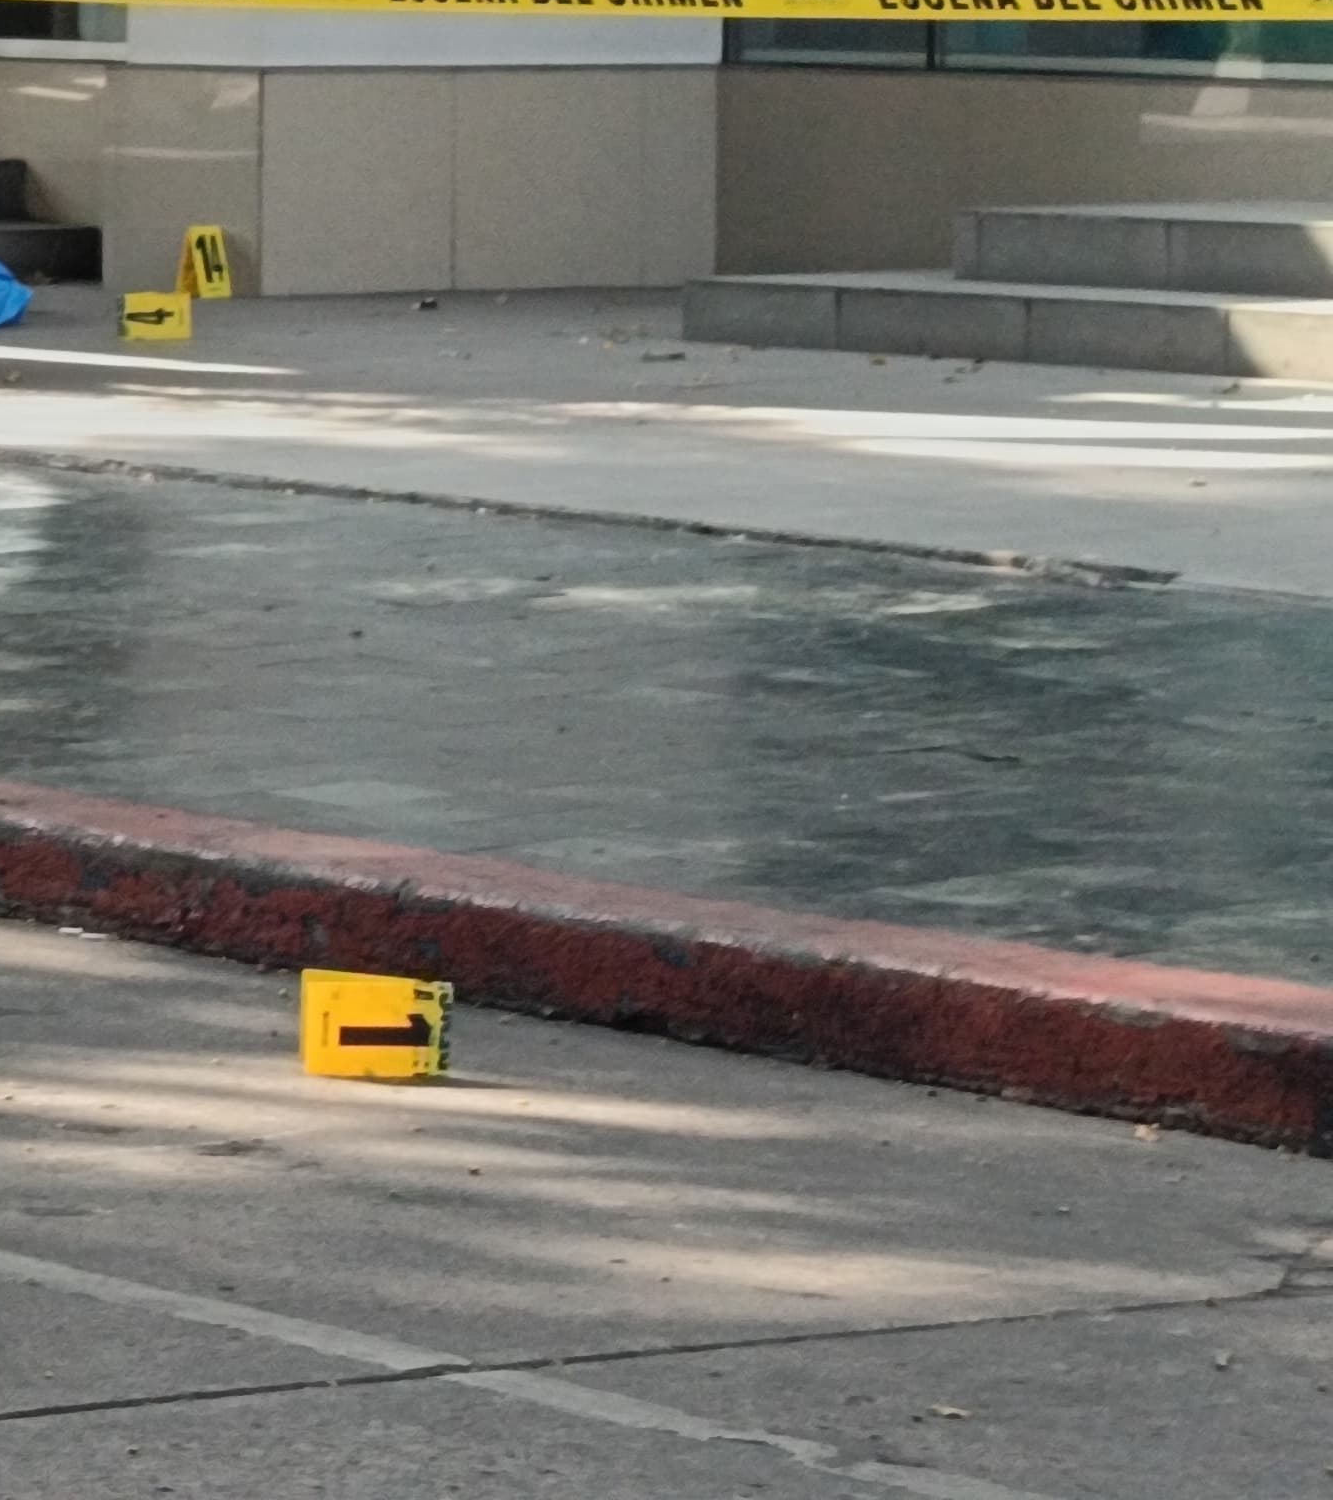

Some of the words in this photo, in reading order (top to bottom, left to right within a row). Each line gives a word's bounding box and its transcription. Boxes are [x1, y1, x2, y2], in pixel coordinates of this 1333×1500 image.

[195, 234, 224, 282] 14
[125, 308, 175, 325] 4
[339, 1013, 432, 1047] 1
